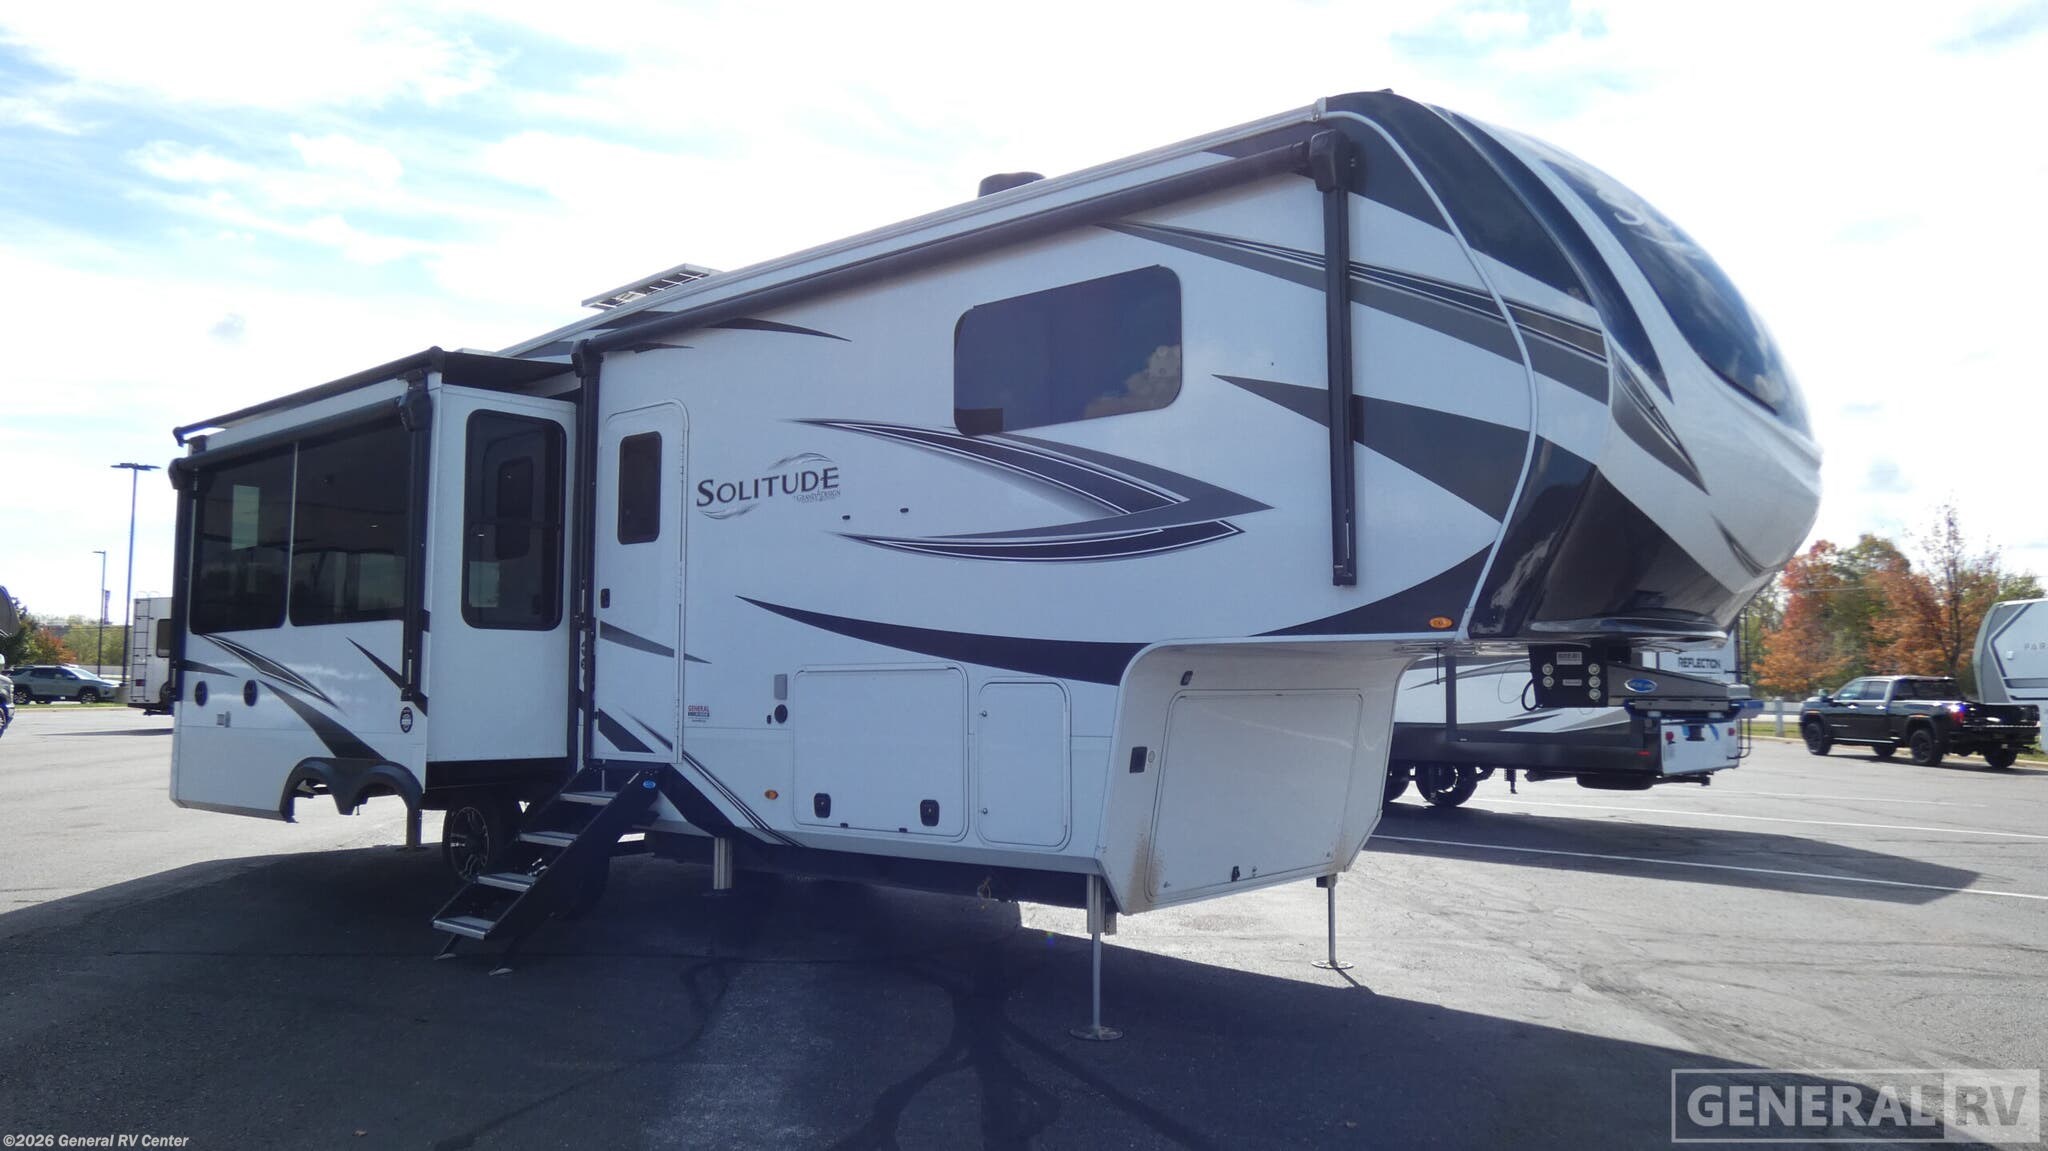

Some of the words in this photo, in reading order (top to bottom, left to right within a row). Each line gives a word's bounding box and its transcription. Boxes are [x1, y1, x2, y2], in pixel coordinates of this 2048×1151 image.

[696, 466, 839, 507] SOLITUDE
[2024, 642, 2048, 650] PAR
[1678, 657, 1721, 669] REFLECTION
